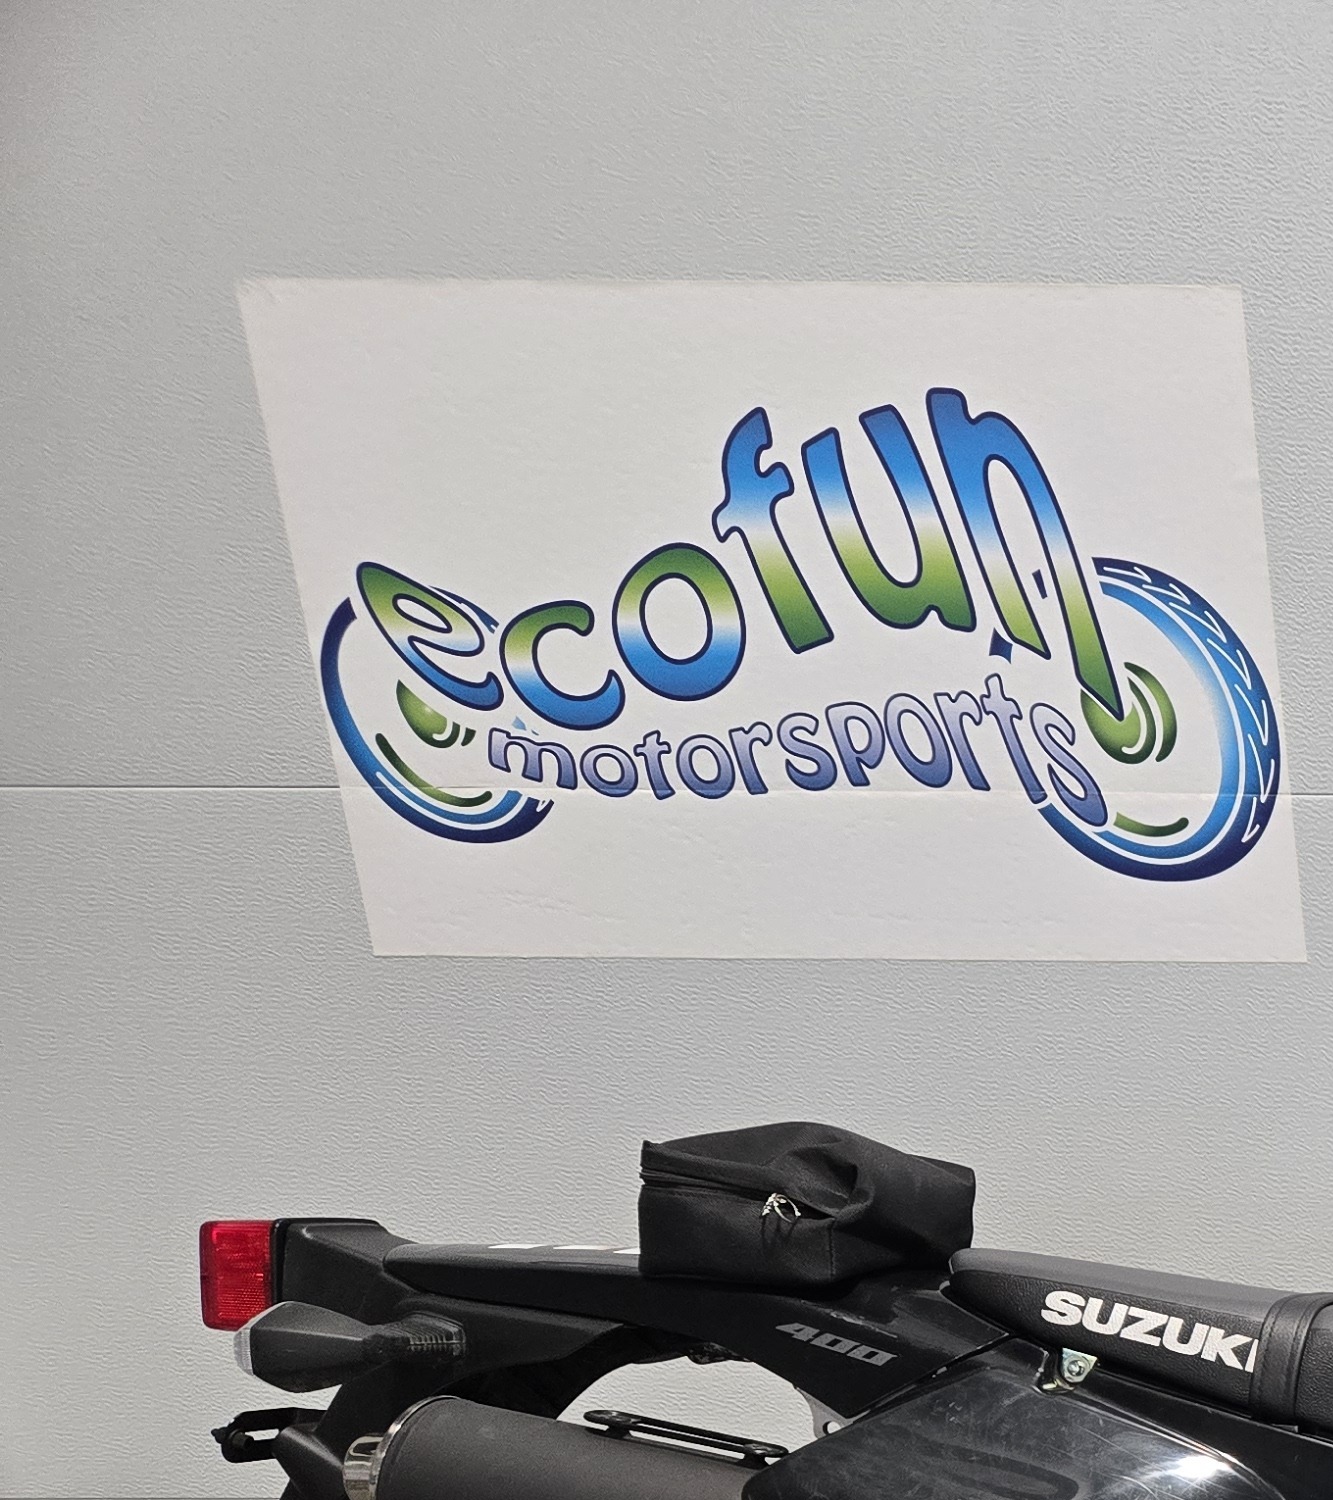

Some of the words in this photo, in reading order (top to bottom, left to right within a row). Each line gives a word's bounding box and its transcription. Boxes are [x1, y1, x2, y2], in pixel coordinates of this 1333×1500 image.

[354, 387, 1124, 730] ecofun
[487, 674, 1110, 827] motorsports
[775, 1322, 898, 1367] 400
